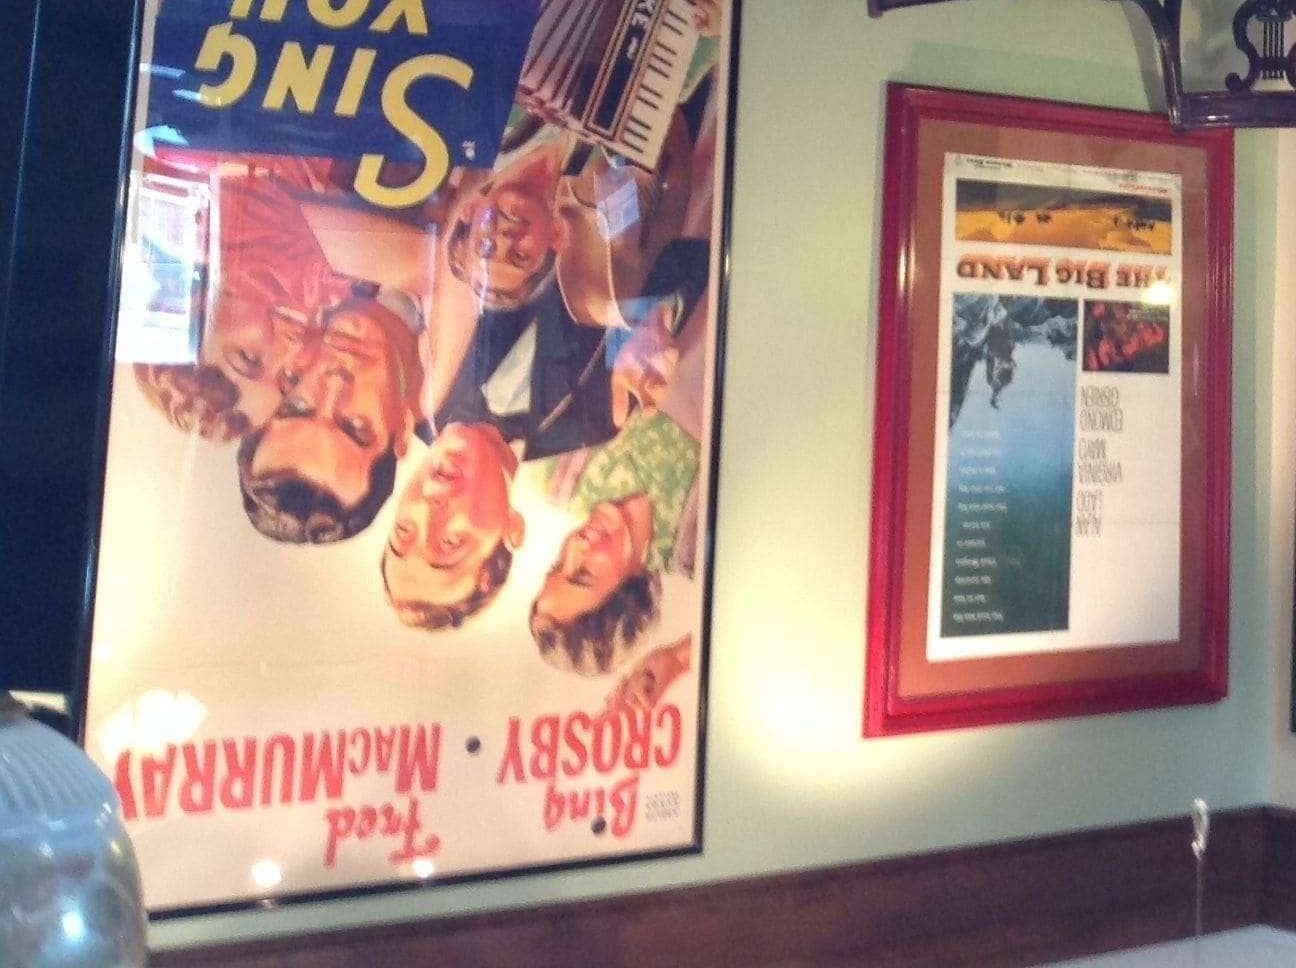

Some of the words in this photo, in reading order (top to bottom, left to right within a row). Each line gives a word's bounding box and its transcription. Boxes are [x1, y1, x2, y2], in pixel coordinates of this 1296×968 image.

[193, 22, 475, 210] SING
[955, 255, 1051, 287] LAND
[1055, 260, 1111, 290] BIG
[1115, 264, 1168, 289] HE
[495, 703, 683, 785] CROSBY
[323, 798, 441, 867] Fred
[541, 776, 640, 841] Bing
